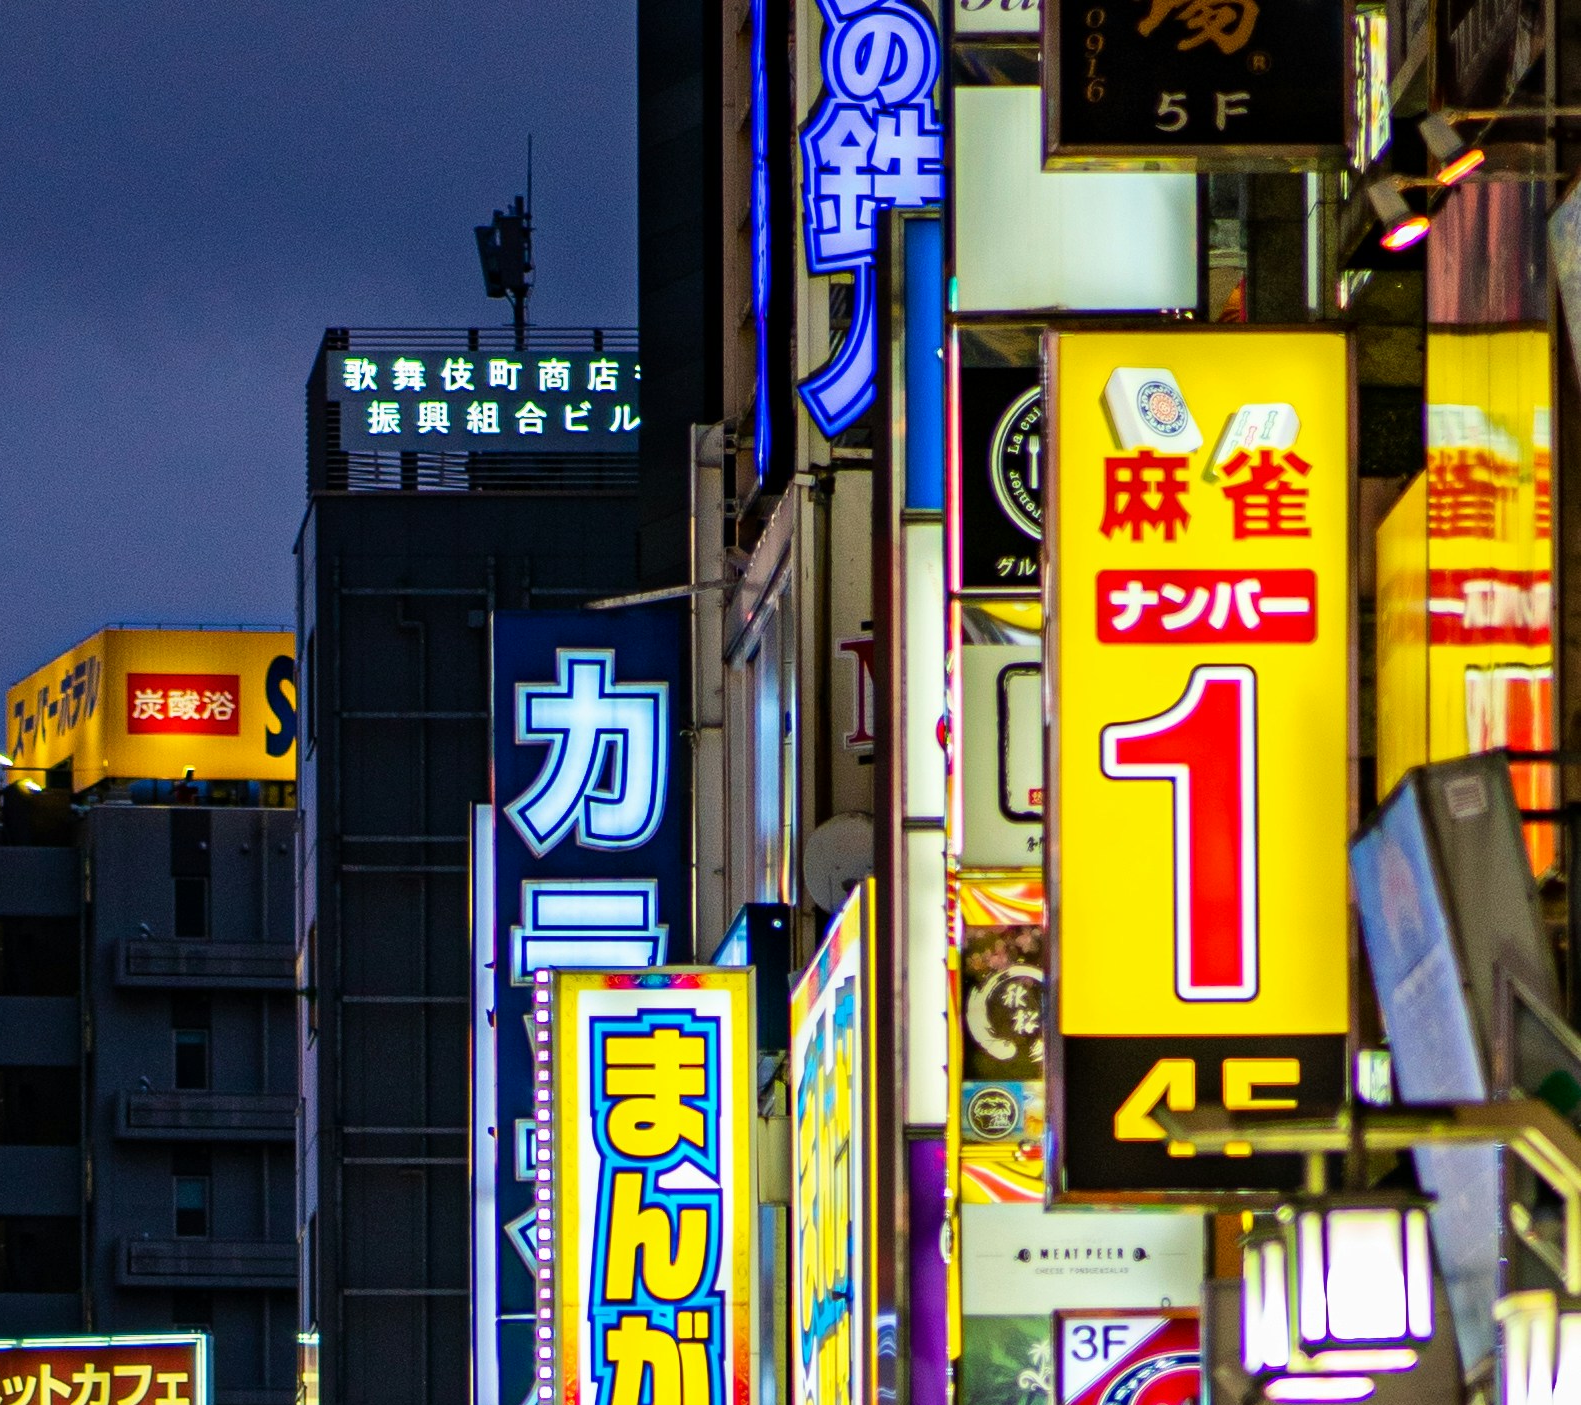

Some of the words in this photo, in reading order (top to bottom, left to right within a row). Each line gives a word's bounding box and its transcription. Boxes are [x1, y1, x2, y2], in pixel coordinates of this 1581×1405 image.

[342, 357, 641, 394] 歌舞伎町商店
[365, 400, 641, 437] 振興組合ビル
[1099, 449, 1314, 543] 麻雀
[1108, 579, 1310, 631] ナンバー
[131, 687, 238, 723] 炭酸浴
[1101, 663, 1257, 1003] 1
[1039, 1247, 1080, 1261] MEAT
[1085, 1247, 1125, 1261] PEER
[1071, 1324, 1131, 1362] 3F
